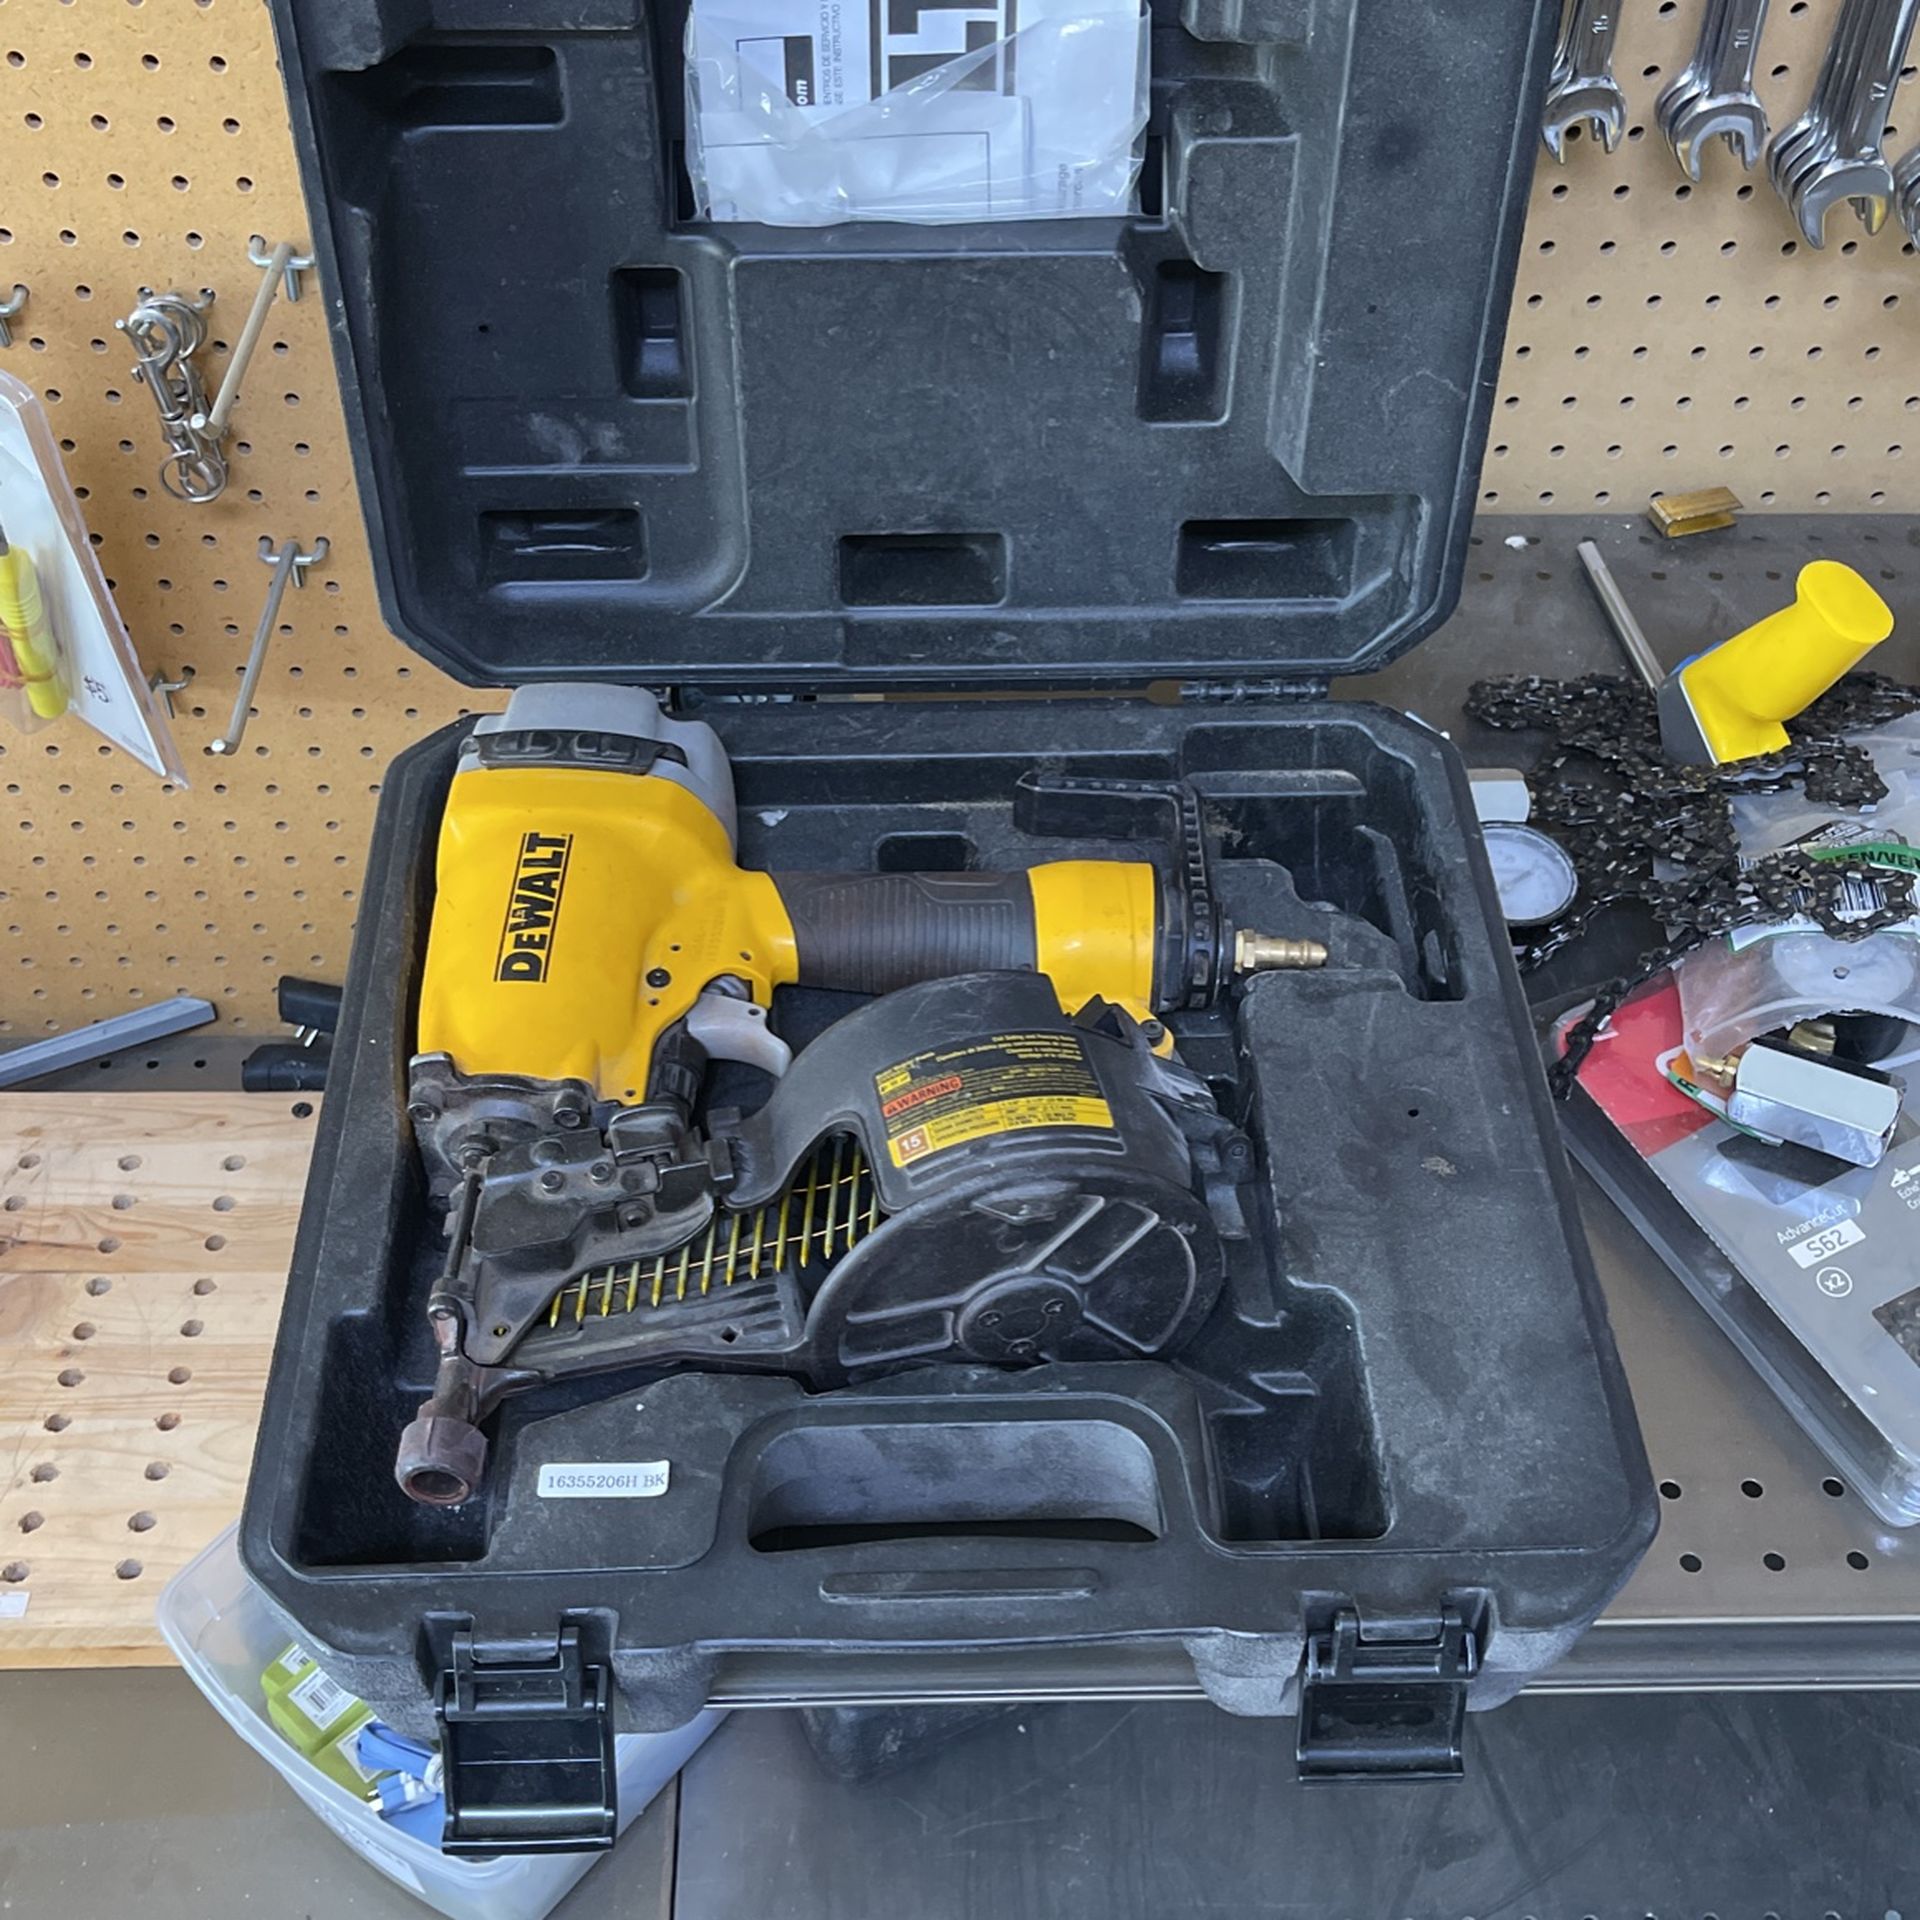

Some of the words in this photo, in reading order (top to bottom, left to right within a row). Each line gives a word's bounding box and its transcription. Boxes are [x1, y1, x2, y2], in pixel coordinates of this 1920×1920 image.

[501, 832, 568, 981] DEWALT
[897, 1078, 960, 1108] WARNING
[1776, 1201, 1848, 1244] AdvanceCut
[1806, 1229, 1848, 1258] S62
[1824, 1273, 1846, 1290] x2
[548, 1475, 638, 1489] 16355206H
[643, 1472, 666, 1488] BK
